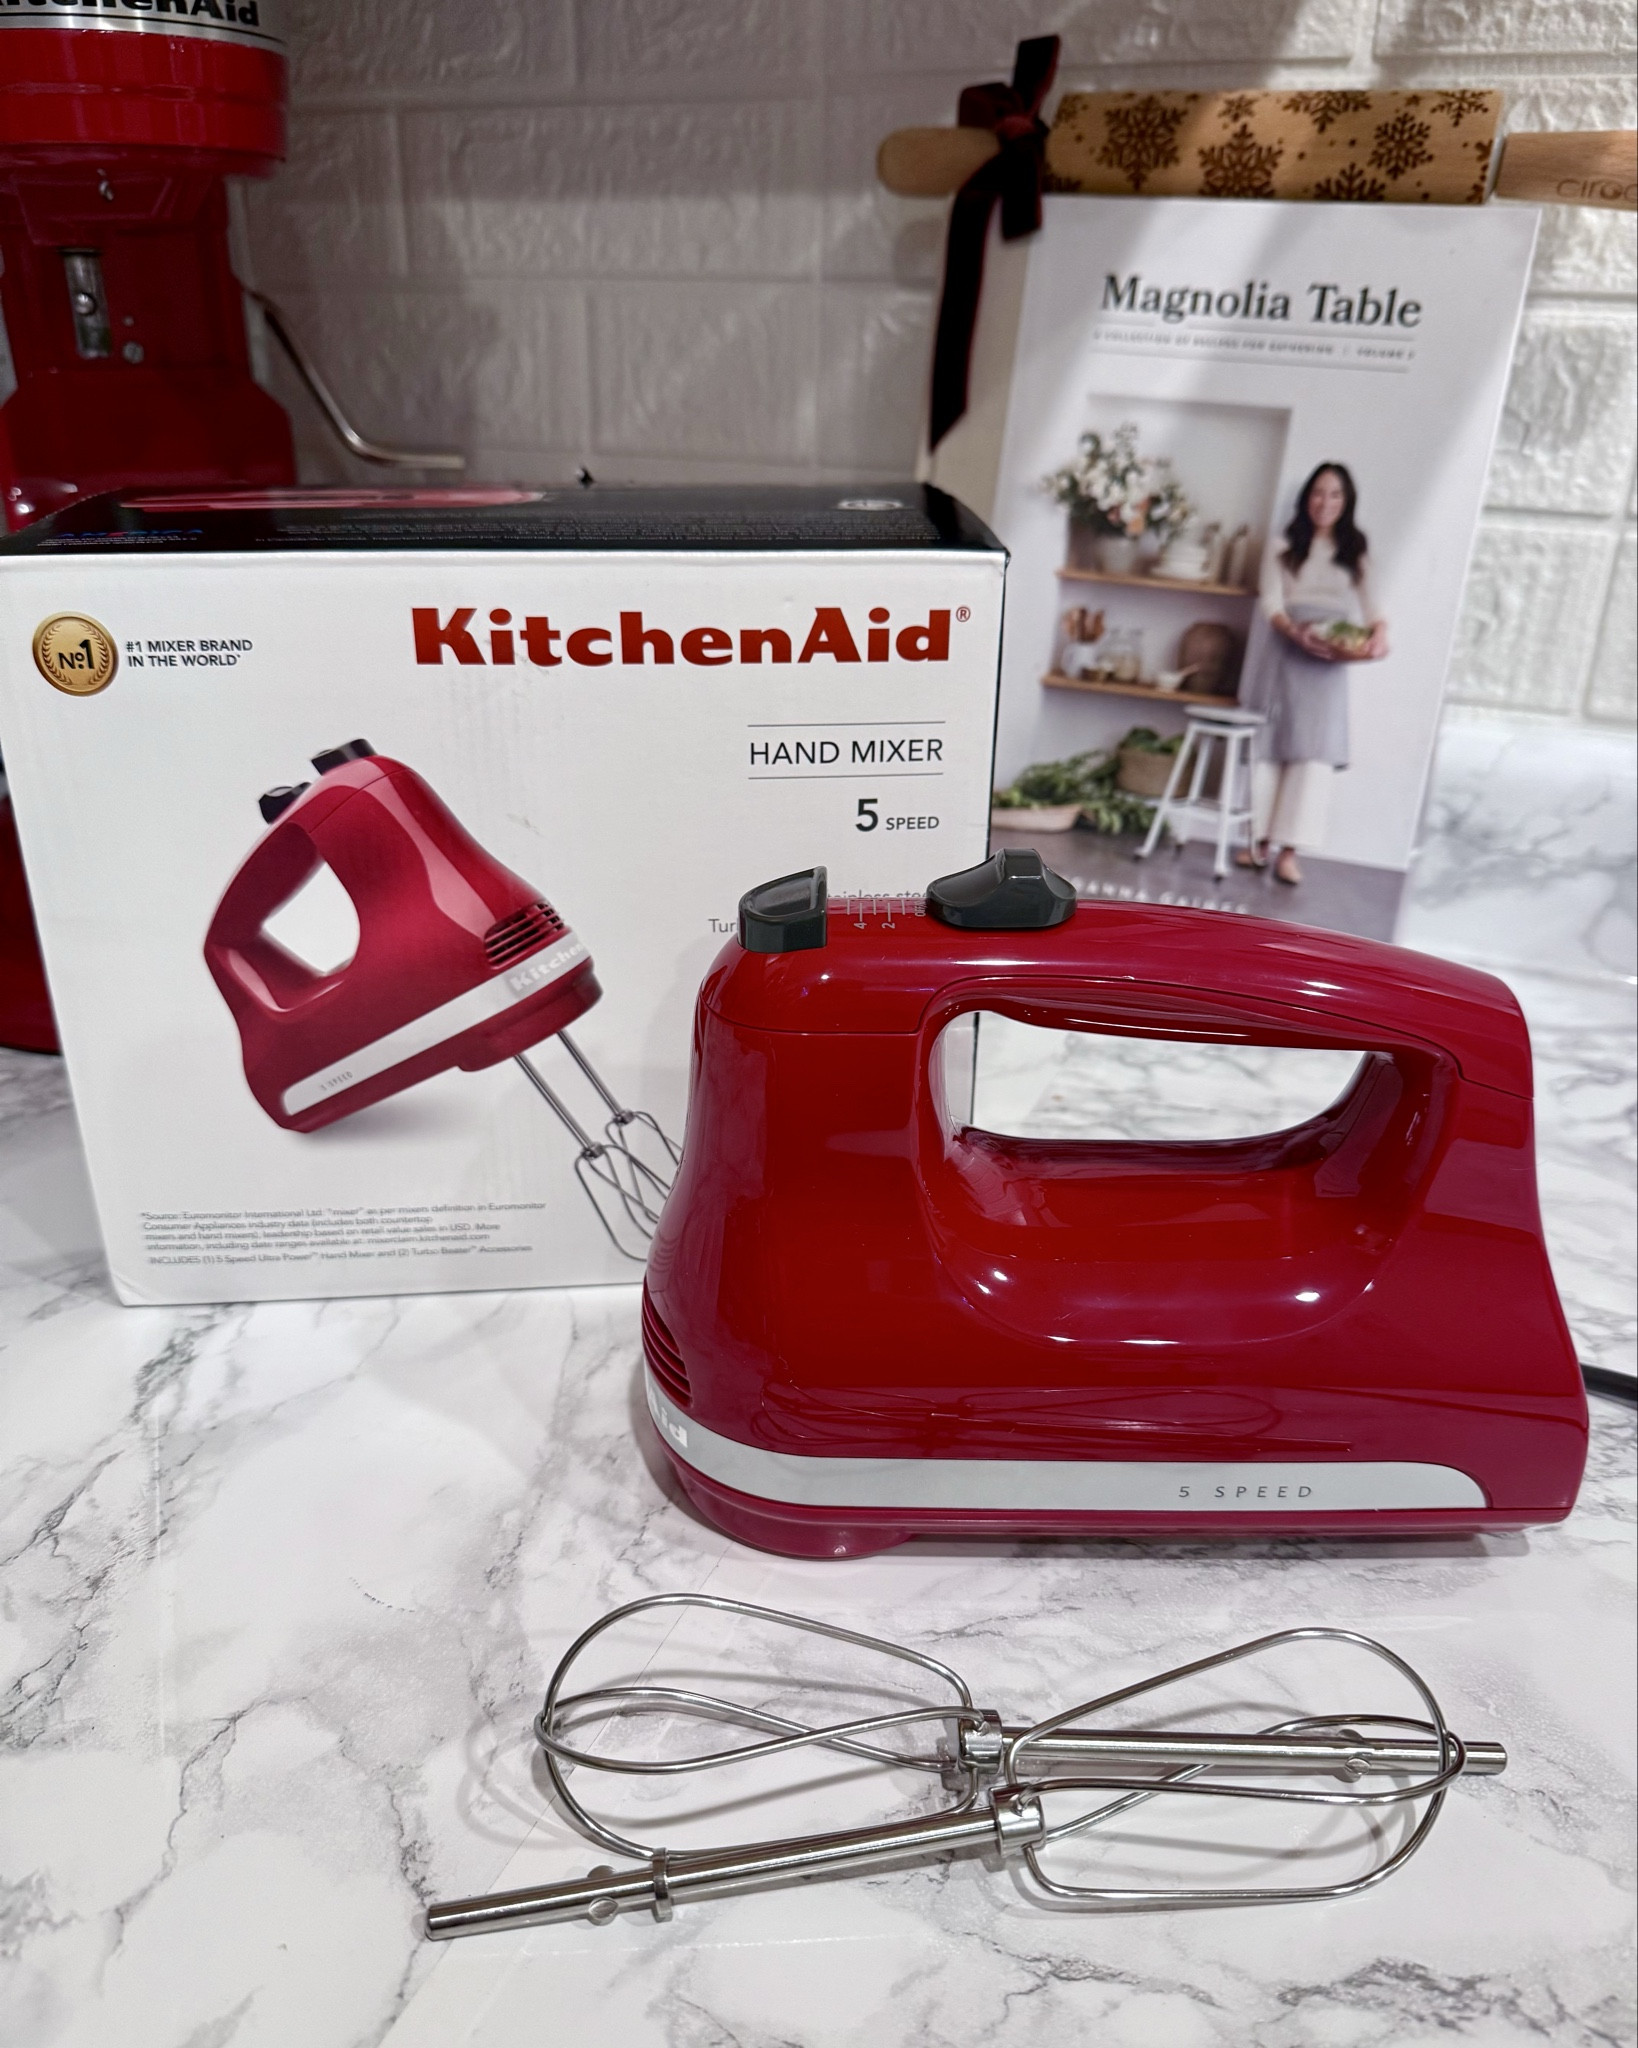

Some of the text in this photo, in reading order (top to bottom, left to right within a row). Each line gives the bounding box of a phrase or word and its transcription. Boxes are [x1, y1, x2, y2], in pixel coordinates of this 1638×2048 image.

[1100, 273, 1422, 328] Magnolia Table
[126, 639, 253, 653] #1 MIXER BRAND
[127, 655, 145, 667] IN
[148, 655, 178, 667] THE
[750, 738, 944, 765] HAND MIXER
[855, 798, 940, 832] 5 SPEED
[853, 922, 867, 930] 4
[881, 922, 896, 930] 2
[1178, 1486, 1312, 1498] 5 SPEED
